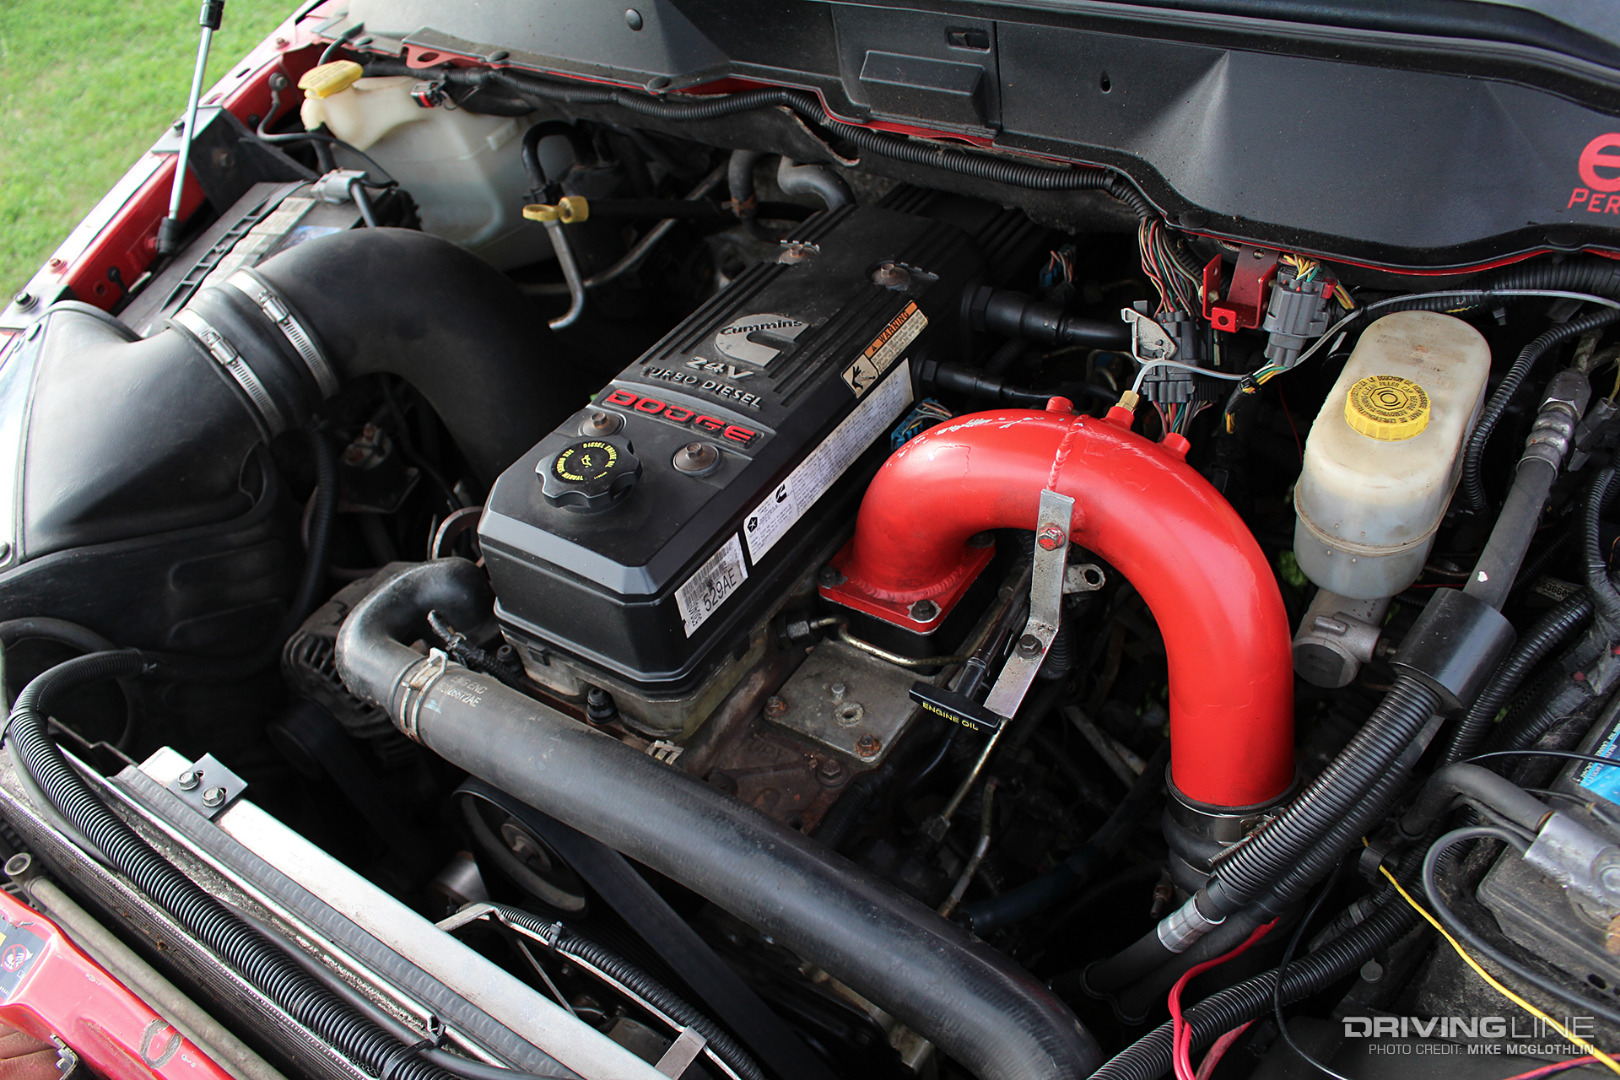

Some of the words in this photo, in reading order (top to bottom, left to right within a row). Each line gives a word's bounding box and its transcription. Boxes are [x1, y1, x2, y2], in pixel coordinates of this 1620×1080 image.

[879, 311, 909, 343] WARNING
[684, 356, 755, 380] 24V
[641, 366, 699, 385] TURBO
[701, 380, 763, 410] DIESEL
[603, 389, 756, 444] DODGE
[703, 567, 738, 612] 529AE
[922, 701, 960, 724] ENGINE
[961, 719, 979, 731] OIL
